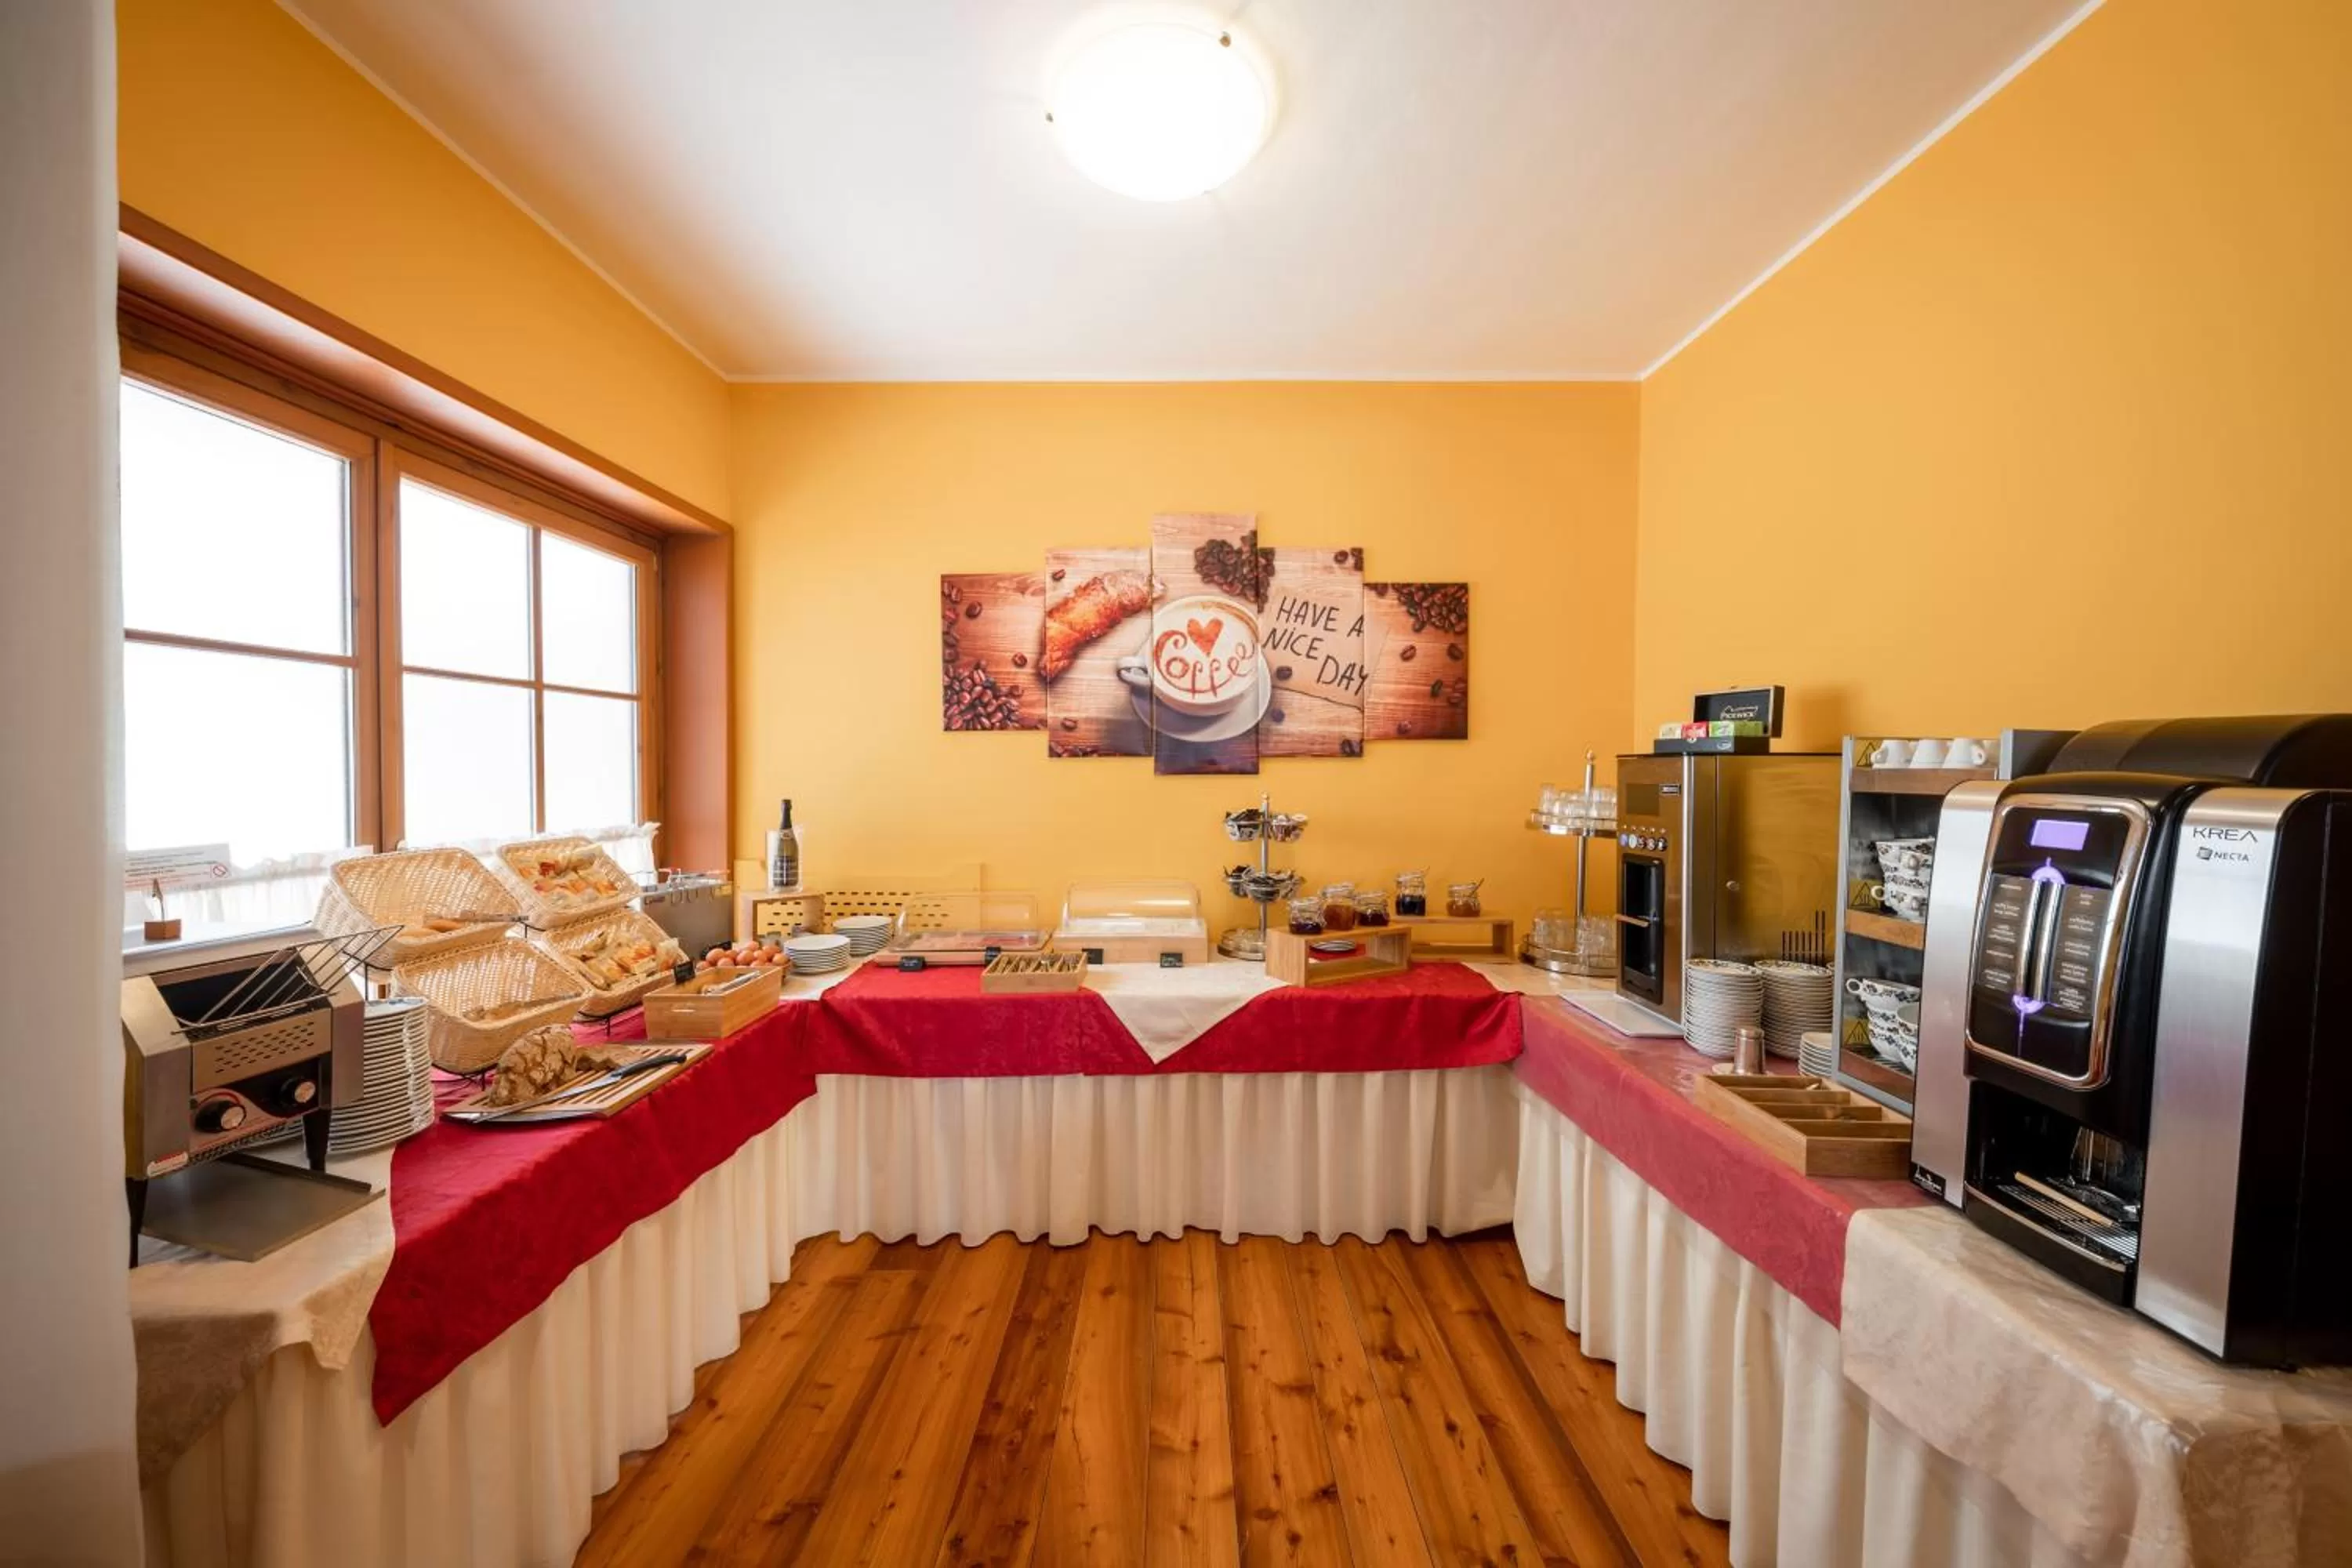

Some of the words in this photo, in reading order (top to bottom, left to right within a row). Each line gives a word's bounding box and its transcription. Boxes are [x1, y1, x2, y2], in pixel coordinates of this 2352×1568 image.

[1276, 596, 1341, 632] HAVE
[1347, 614, 1364, 637] A
[1261, 627, 1324, 660] NICE
[1153, 630, 1256, 699] Coffee
[1316, 654, 1370, 696] DAY
[2193, 827, 2258, 843] KREA
[2213, 851, 2249, 862] NECTA
